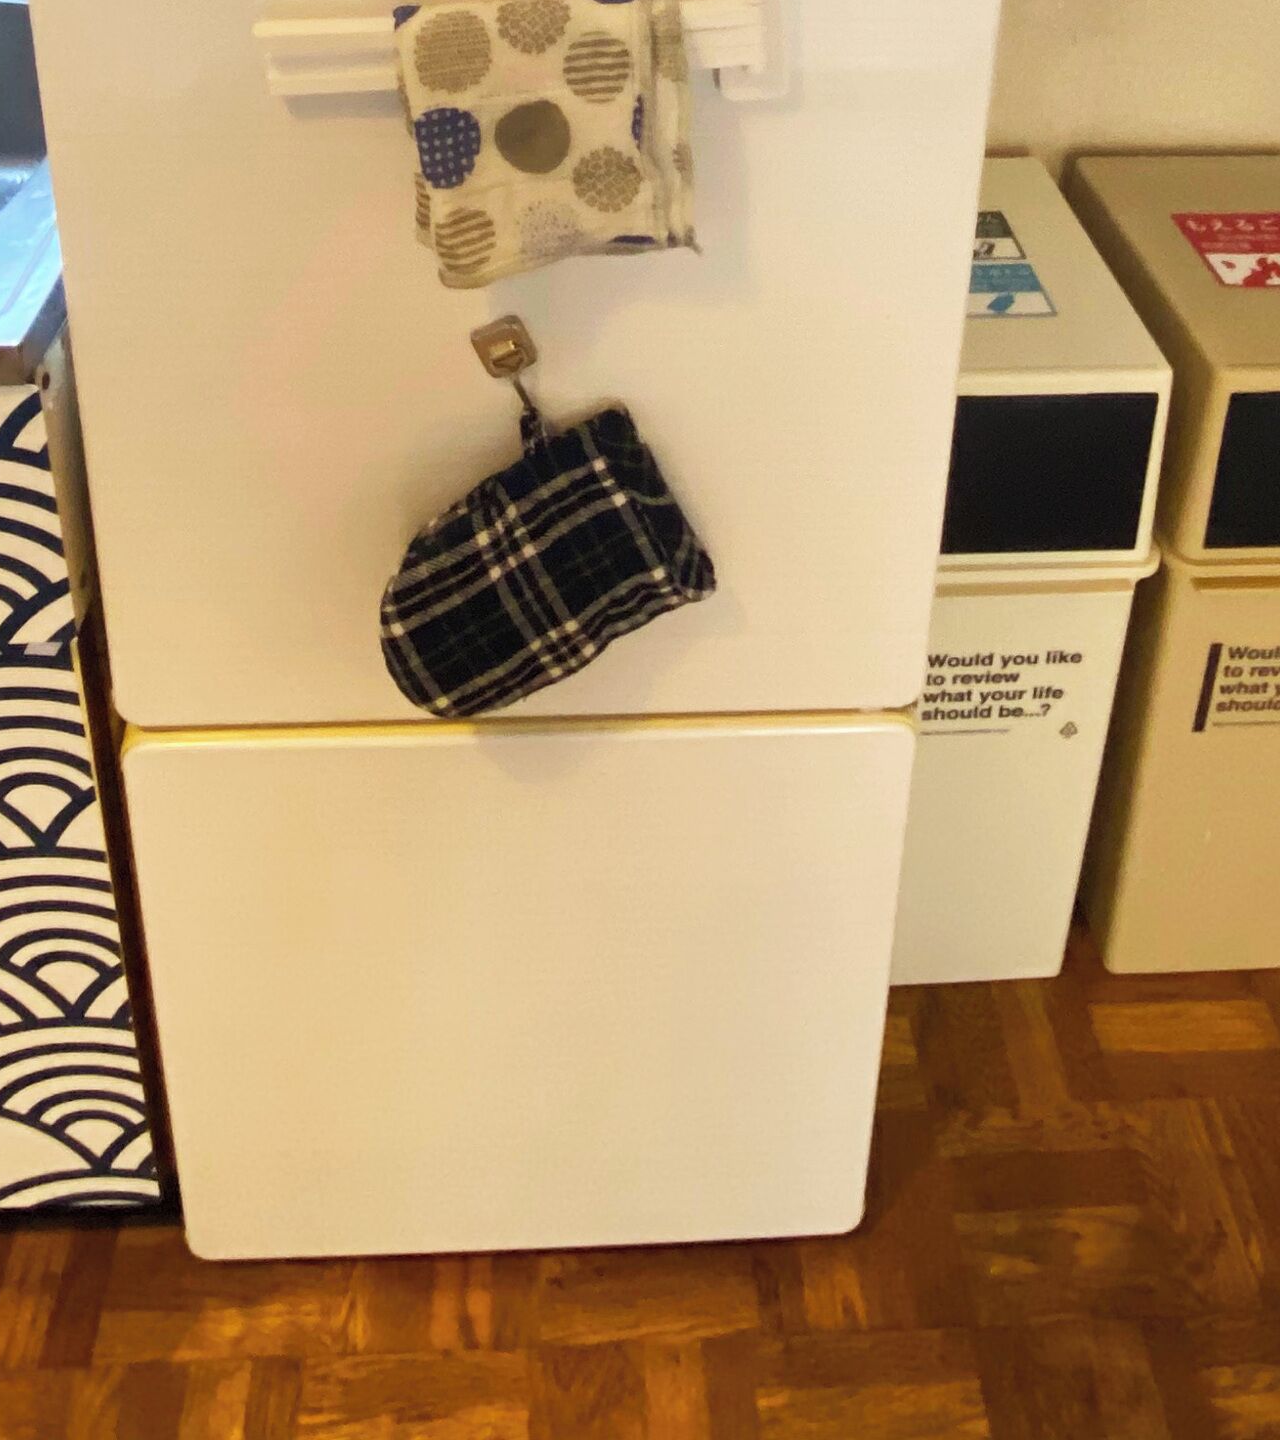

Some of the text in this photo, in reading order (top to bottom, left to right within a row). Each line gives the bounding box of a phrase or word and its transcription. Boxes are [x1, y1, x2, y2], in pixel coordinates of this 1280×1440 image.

[926, 649, 1083, 670] Would you like
[925, 670, 1020, 687] to review
[1222, 665, 1243, 678] to
[922, 686, 1065, 705] what your life
[1219, 680, 1269, 695] what
[920, 705, 992, 722] should
